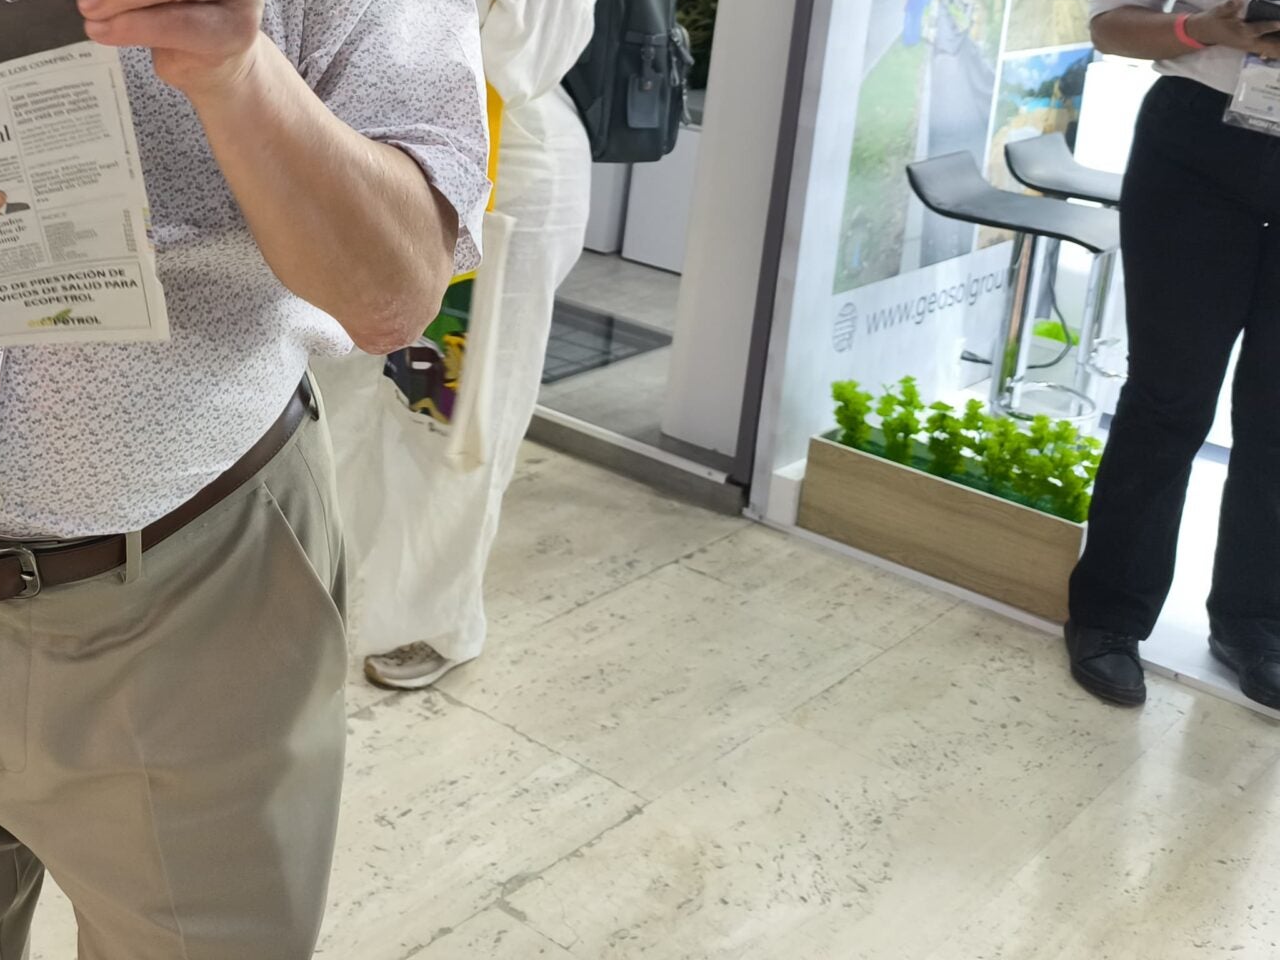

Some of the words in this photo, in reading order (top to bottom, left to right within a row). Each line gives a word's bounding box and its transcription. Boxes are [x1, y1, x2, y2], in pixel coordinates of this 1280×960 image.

[7, 64, 27, 75] LOS
[14, 224, 26, 233] de
[10, 281, 28, 291] DE
[30, 269, 105, 288] PRESTACIÓN
[108, 267, 126, 278] DE
[41, 286, 59, 297] DE
[60, 279, 102, 293] SALUD
[105, 278, 138, 290] PARA
[24, 292, 95, 308] ECOPETROL
[865, 269, 1011, 334] www.geosolgrou
